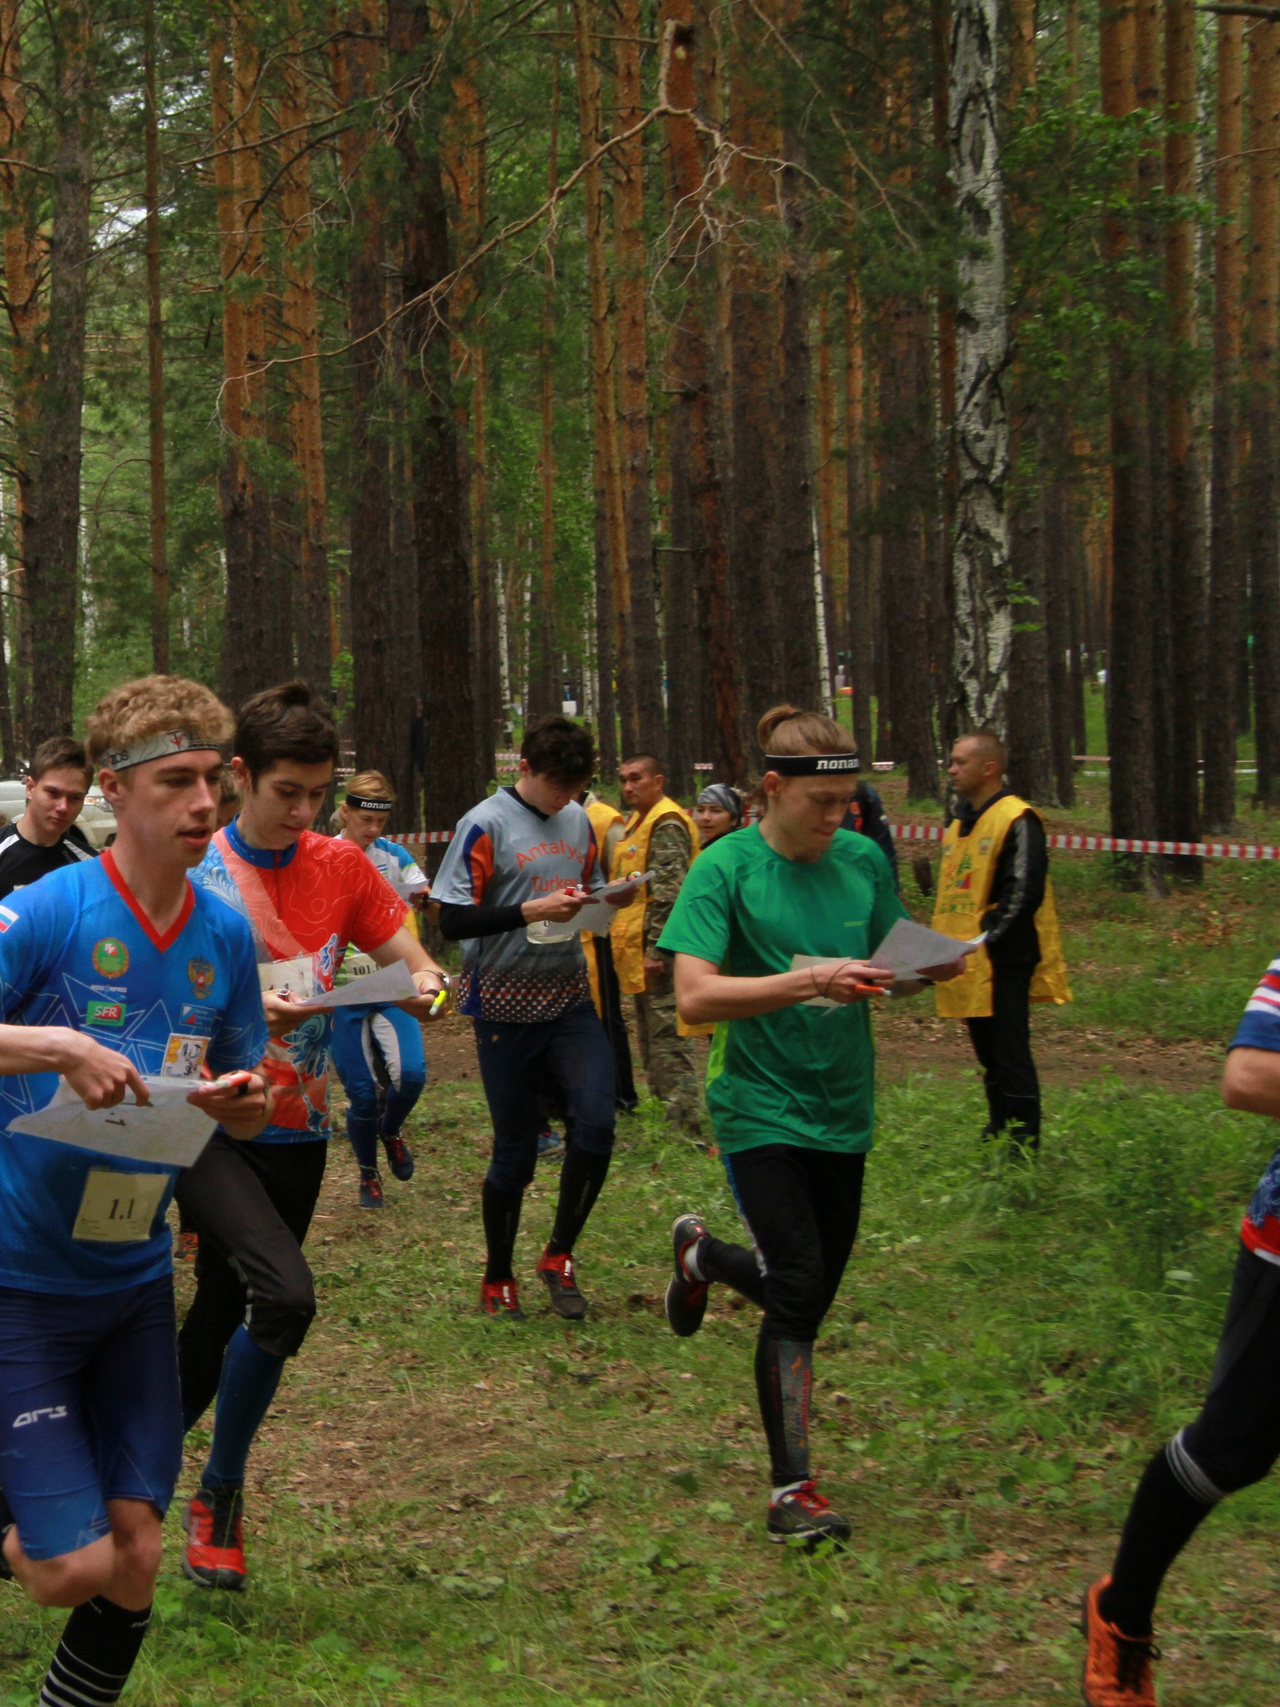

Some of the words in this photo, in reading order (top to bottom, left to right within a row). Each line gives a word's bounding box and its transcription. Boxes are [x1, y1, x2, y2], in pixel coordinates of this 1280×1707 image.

[515, 840, 586, 869] Antalya
[94, 1005, 119, 1018] SFR
[107, 1198, 136, 1220] 1.1
